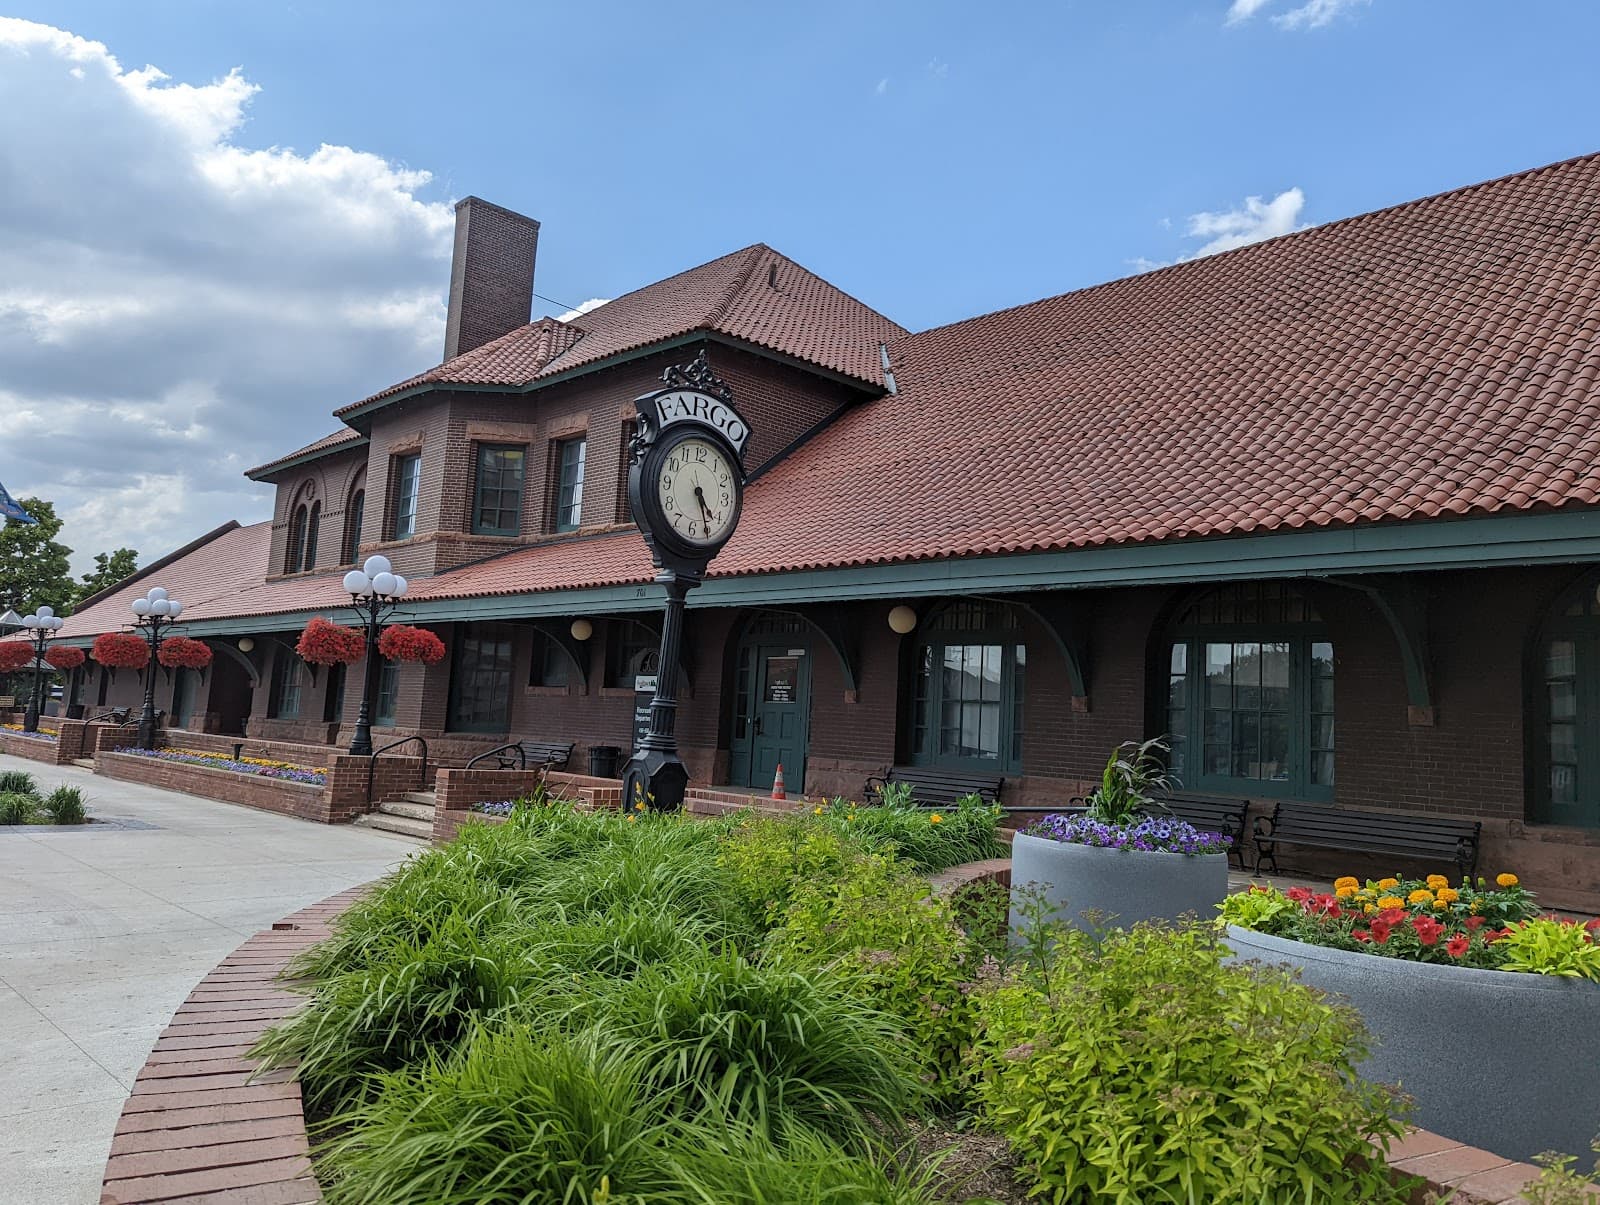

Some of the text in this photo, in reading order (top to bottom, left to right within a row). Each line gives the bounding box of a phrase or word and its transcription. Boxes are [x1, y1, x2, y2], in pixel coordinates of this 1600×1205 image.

[657, 395, 744, 442] FARGO
[682, 447, 690, 462] 11
[696, 447, 708, 463] 12
[669, 457, 679, 472] 10
[713, 459, 718, 473] 1
[663, 475, 672, 490] 9
[720, 473, 728, 488] 2
[665, 496, 674, 511] 8
[721, 492, 729, 507] 3
[674, 513, 682, 528] 7
[714, 511, 723, 524] 4
[688, 521, 697, 536] 6
